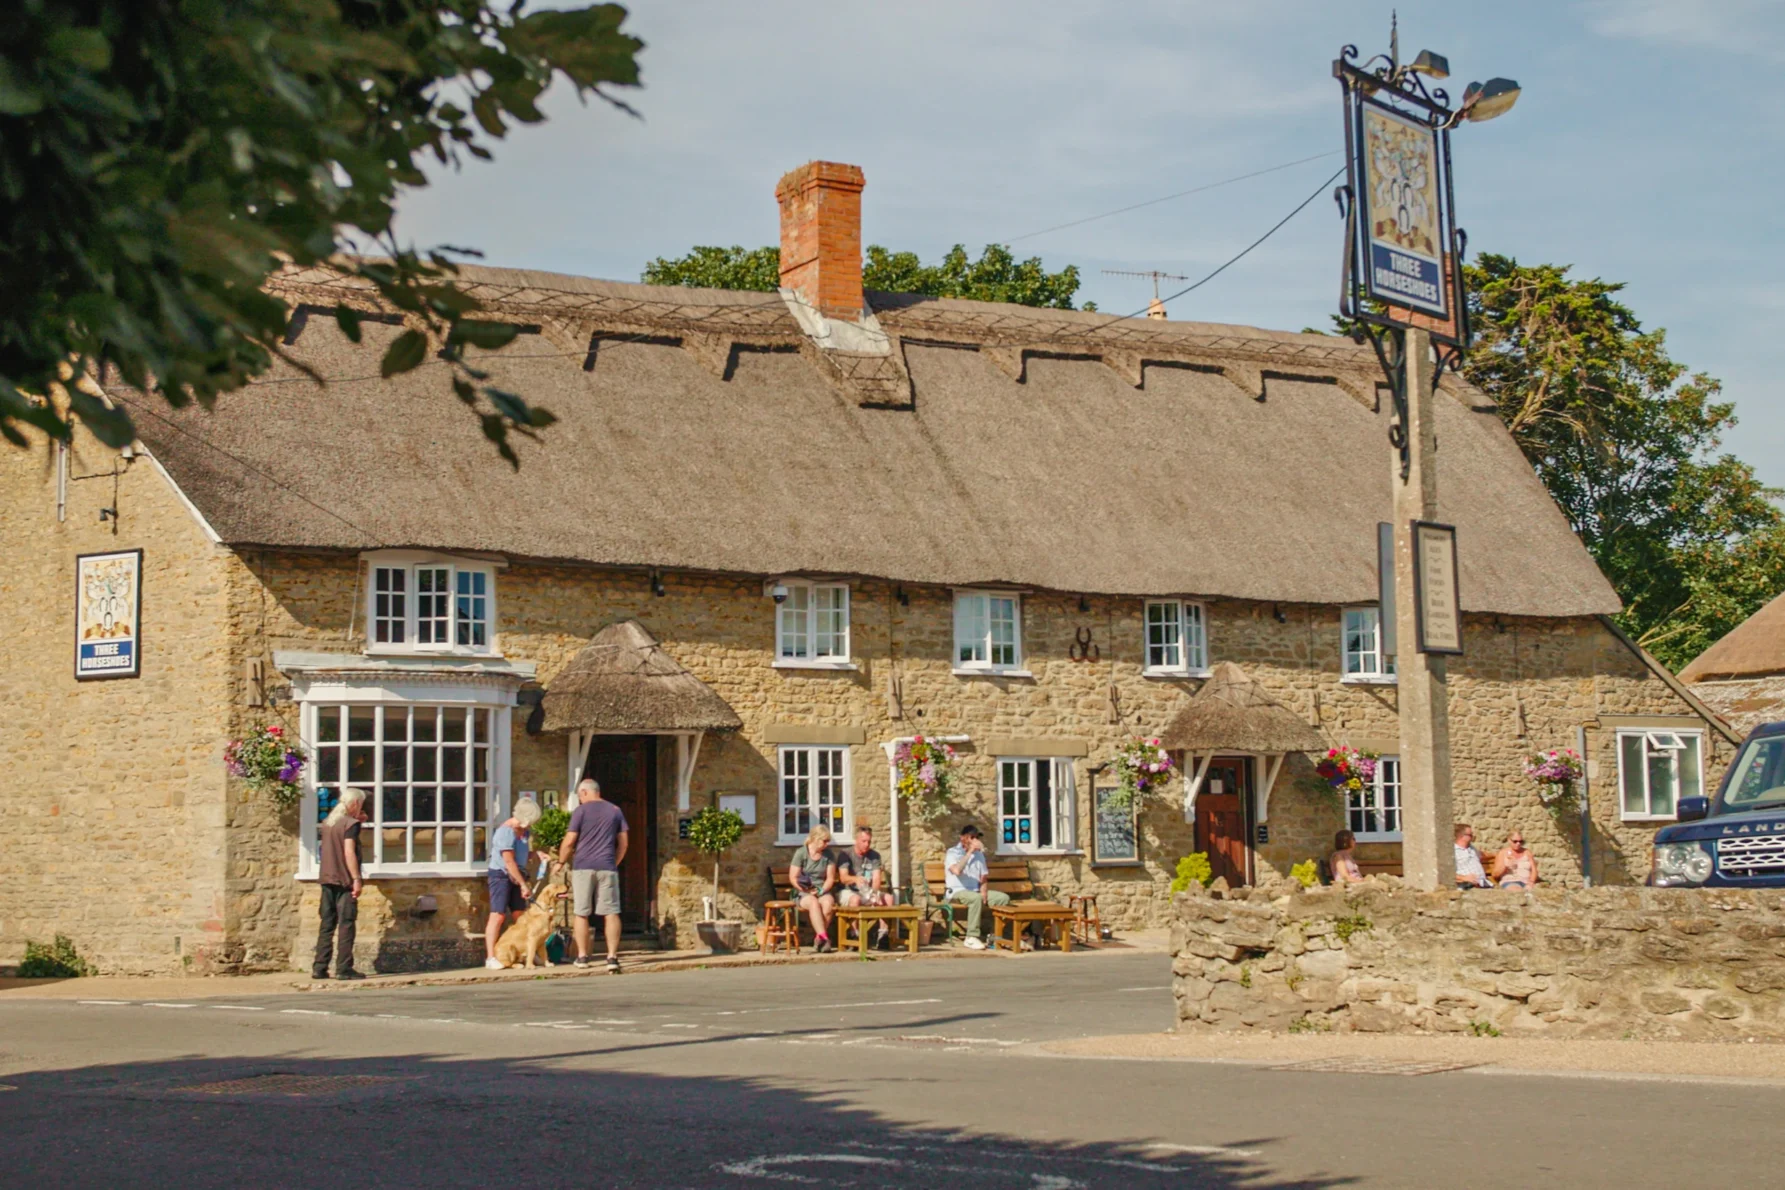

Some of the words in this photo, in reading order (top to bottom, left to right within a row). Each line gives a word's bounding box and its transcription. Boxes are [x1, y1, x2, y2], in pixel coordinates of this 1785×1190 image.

[1389, 252, 1421, 278] THREE
[1375, 266, 1437, 301] HORSESHOES
[94, 644, 119, 656] THREE
[82, 654, 130, 668] HORSESHOES
[1723, 823, 1785, 834] LAND
